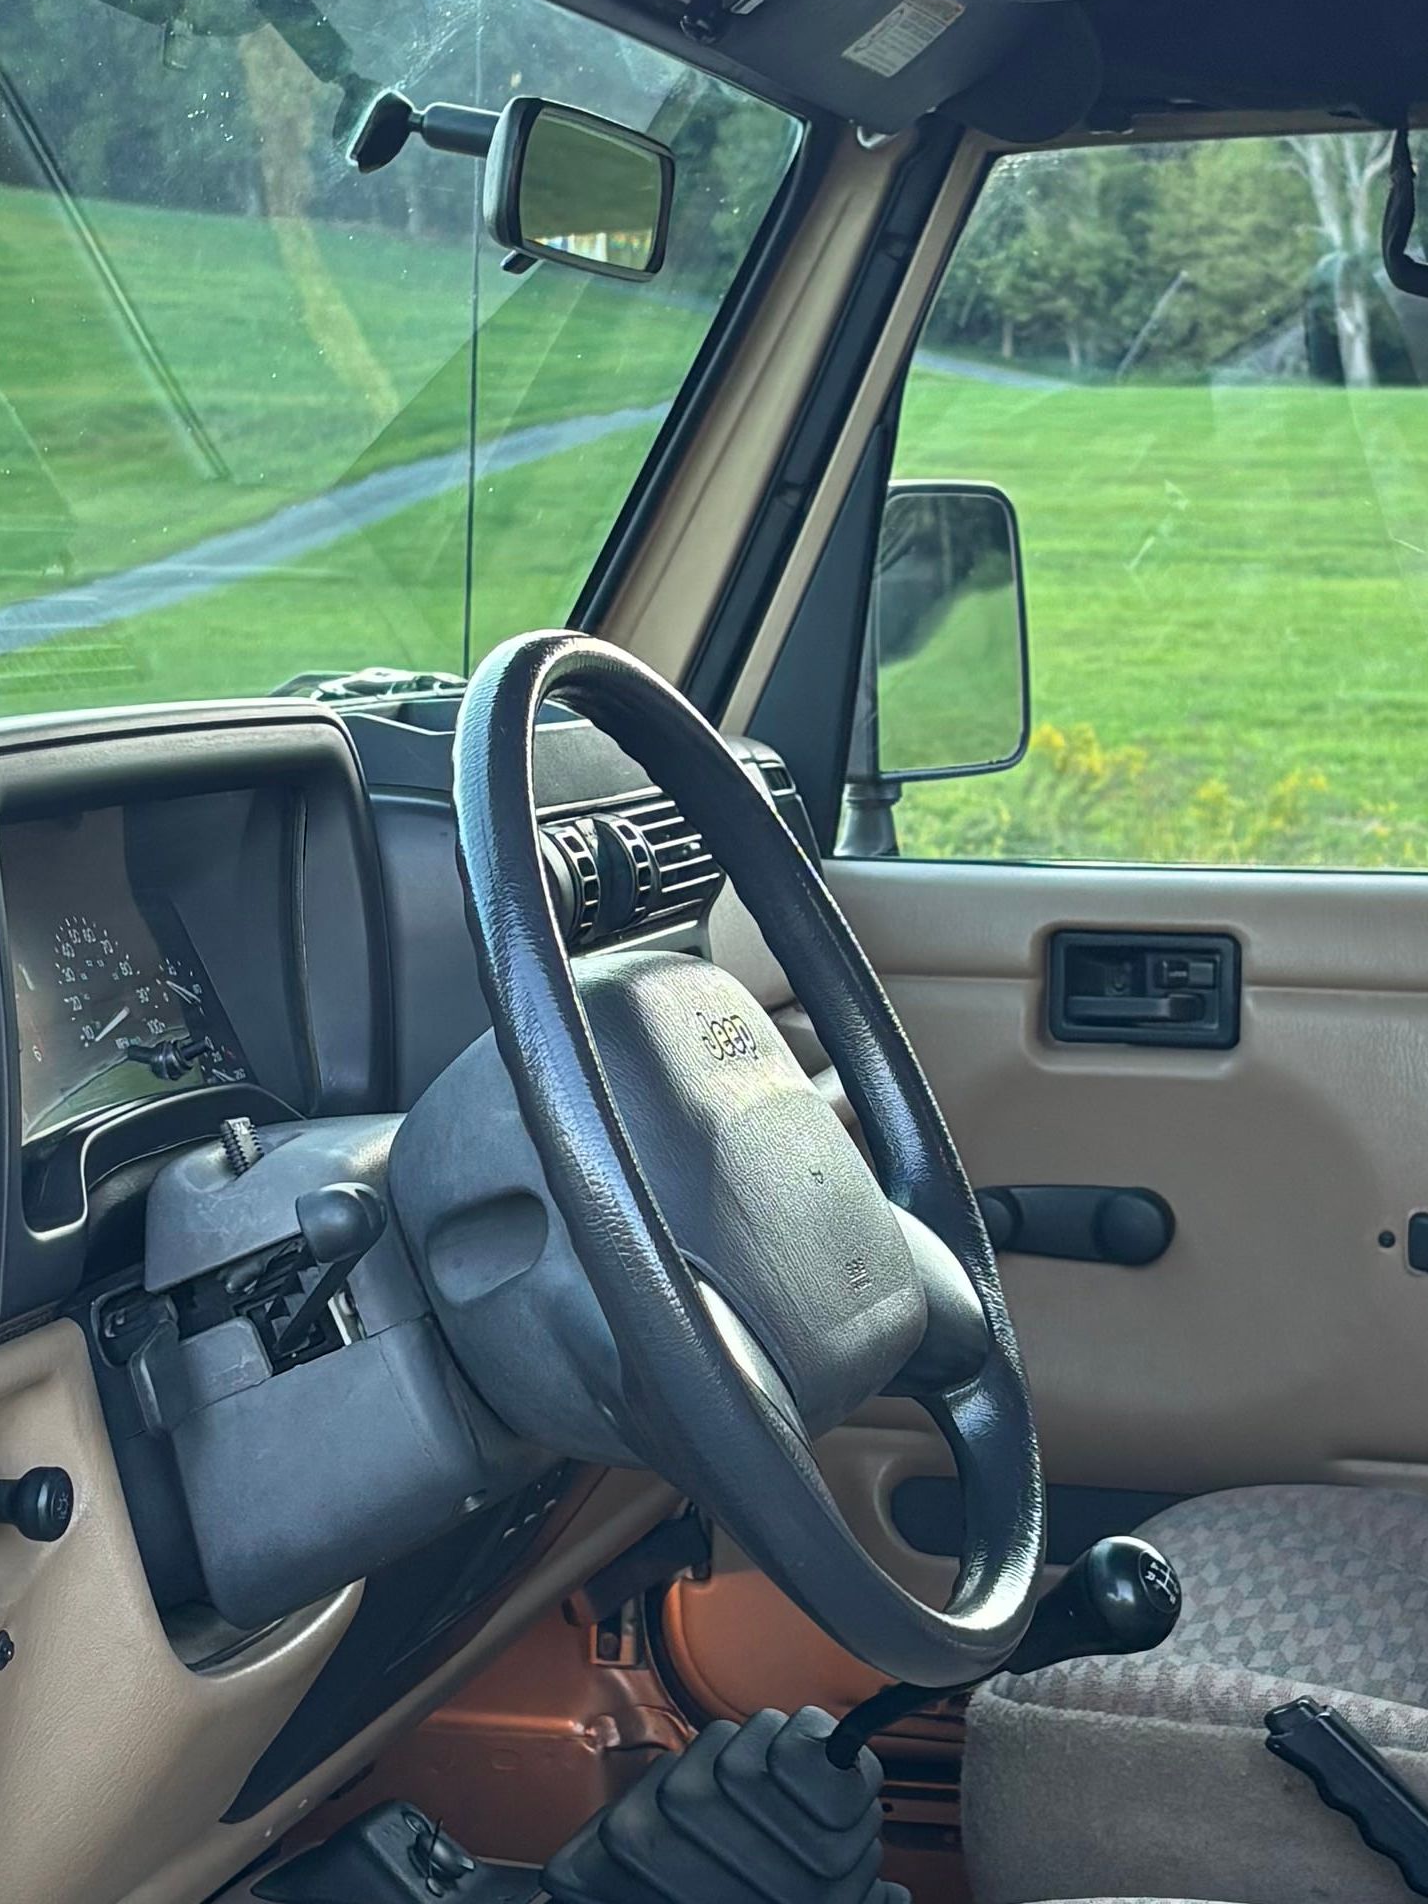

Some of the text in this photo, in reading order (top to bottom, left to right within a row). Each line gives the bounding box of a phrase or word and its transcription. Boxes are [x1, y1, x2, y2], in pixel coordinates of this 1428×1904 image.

[67, 929, 81, 944] 50
[81, 928, 96, 943] 60
[61, 942, 75, 958] 40
[100, 939, 114, 955] 70
[119, 961, 133, 976] 80
[70, 996, 83, 1011] 20
[82, 1025, 94, 1040] 10
[696, 1012, 759, 1061] Jeep
[1144, 1570, 1156, 1581] R
